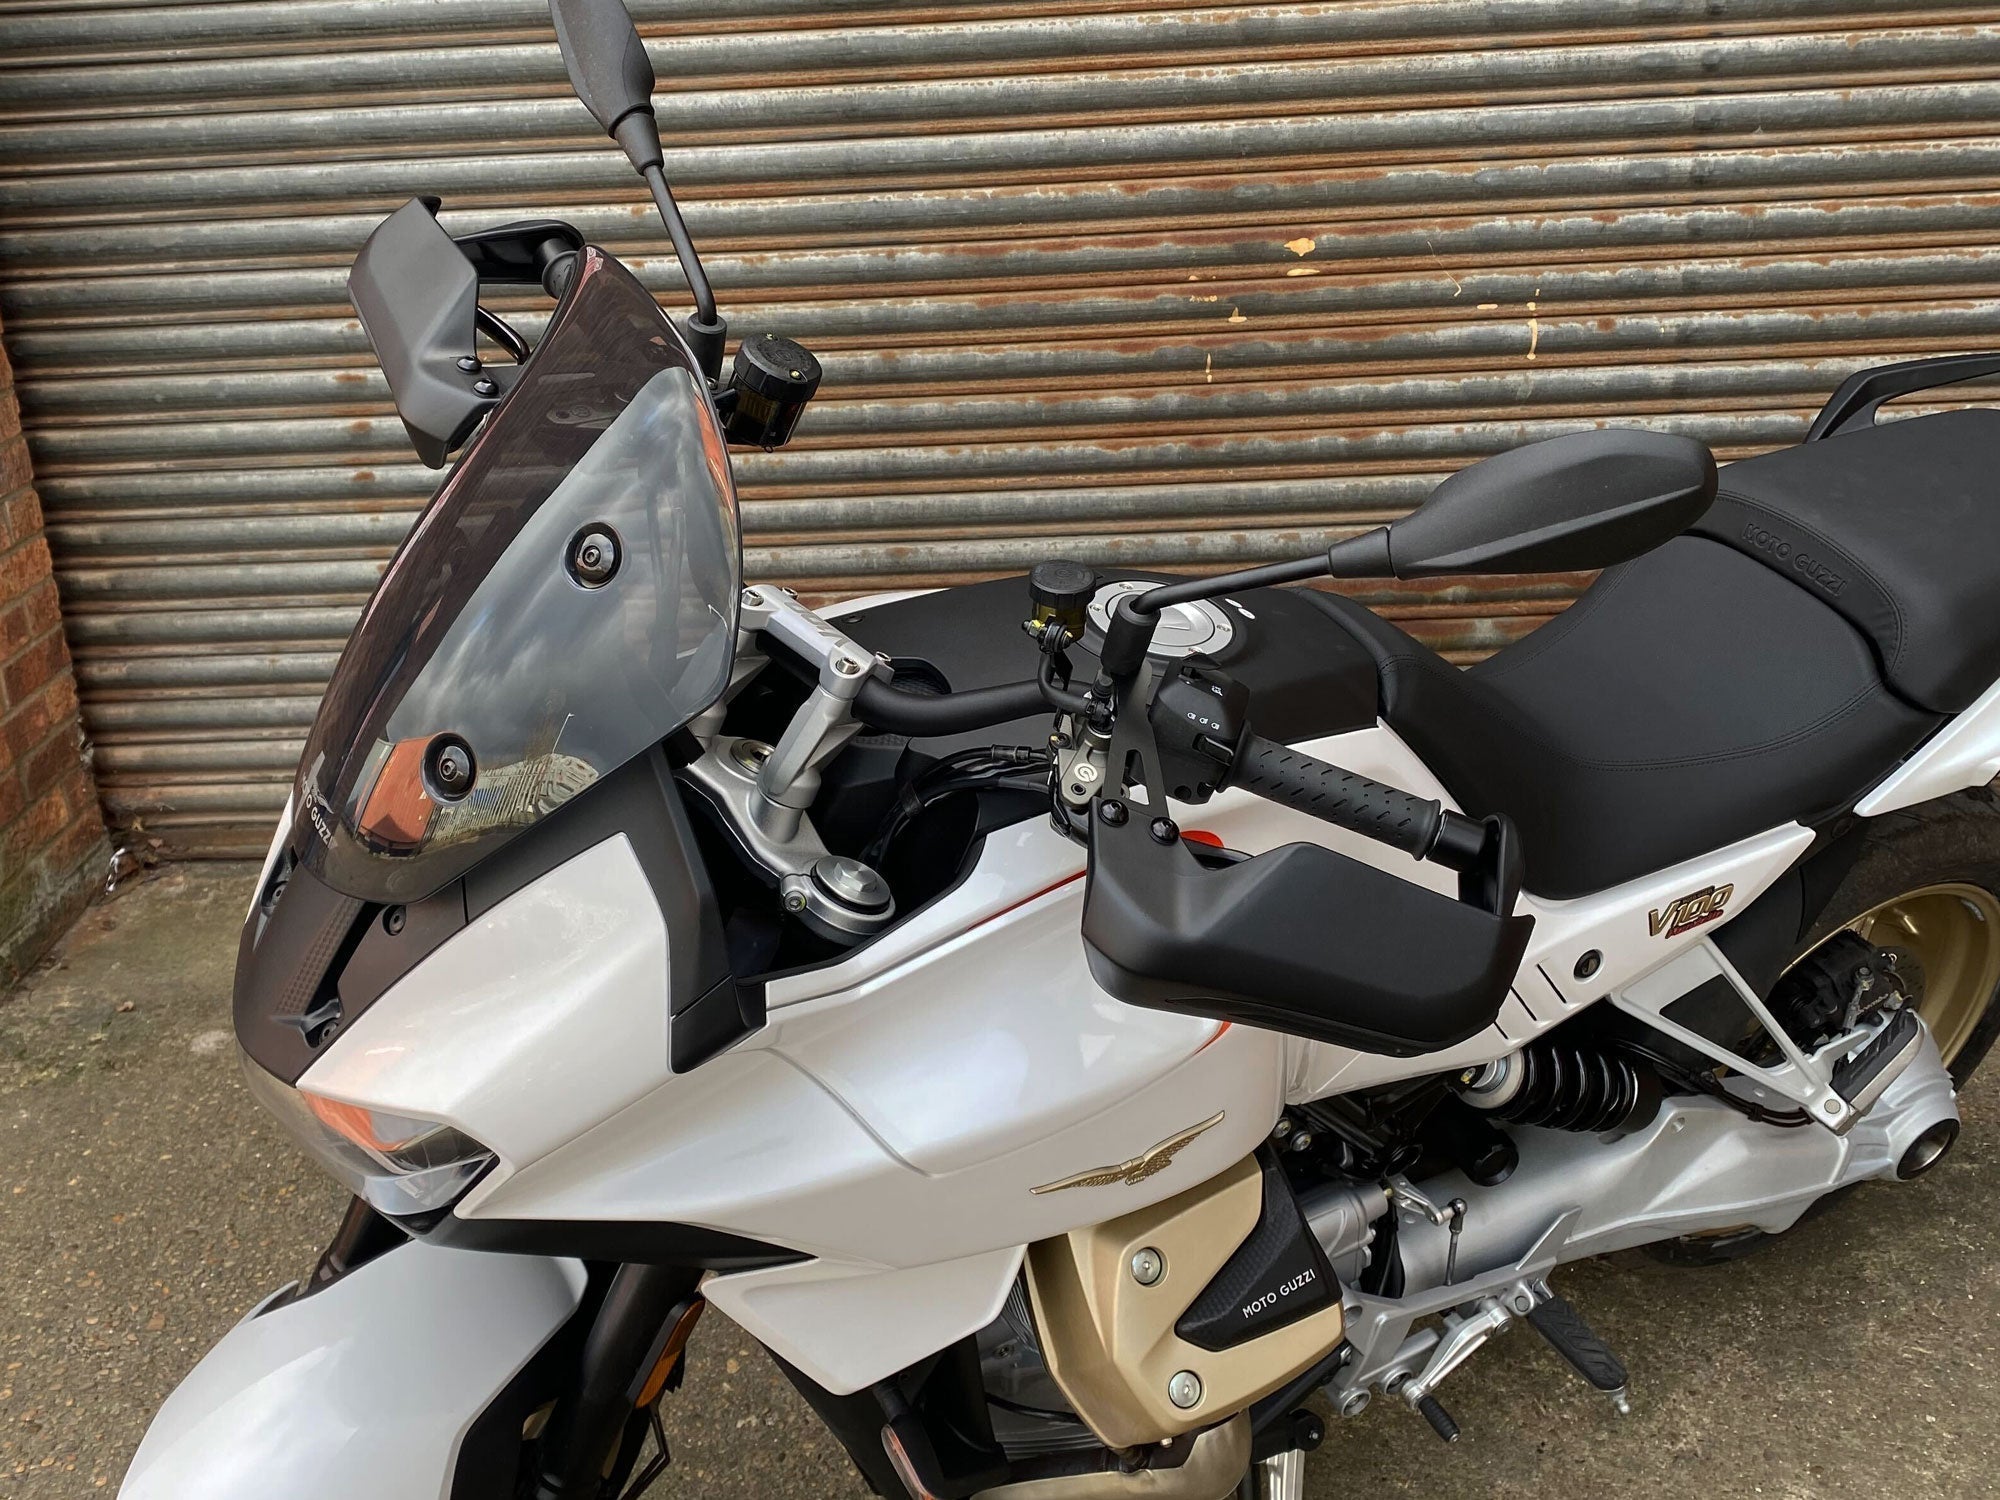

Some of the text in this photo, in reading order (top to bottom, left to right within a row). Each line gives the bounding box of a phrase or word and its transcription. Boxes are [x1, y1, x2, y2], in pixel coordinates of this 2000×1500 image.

[1742, 523, 1847, 597] MOTO GUZZI
[1648, 883, 1734, 937] V100
[1242, 1268, 1316, 1319] MOTO GUZZI
